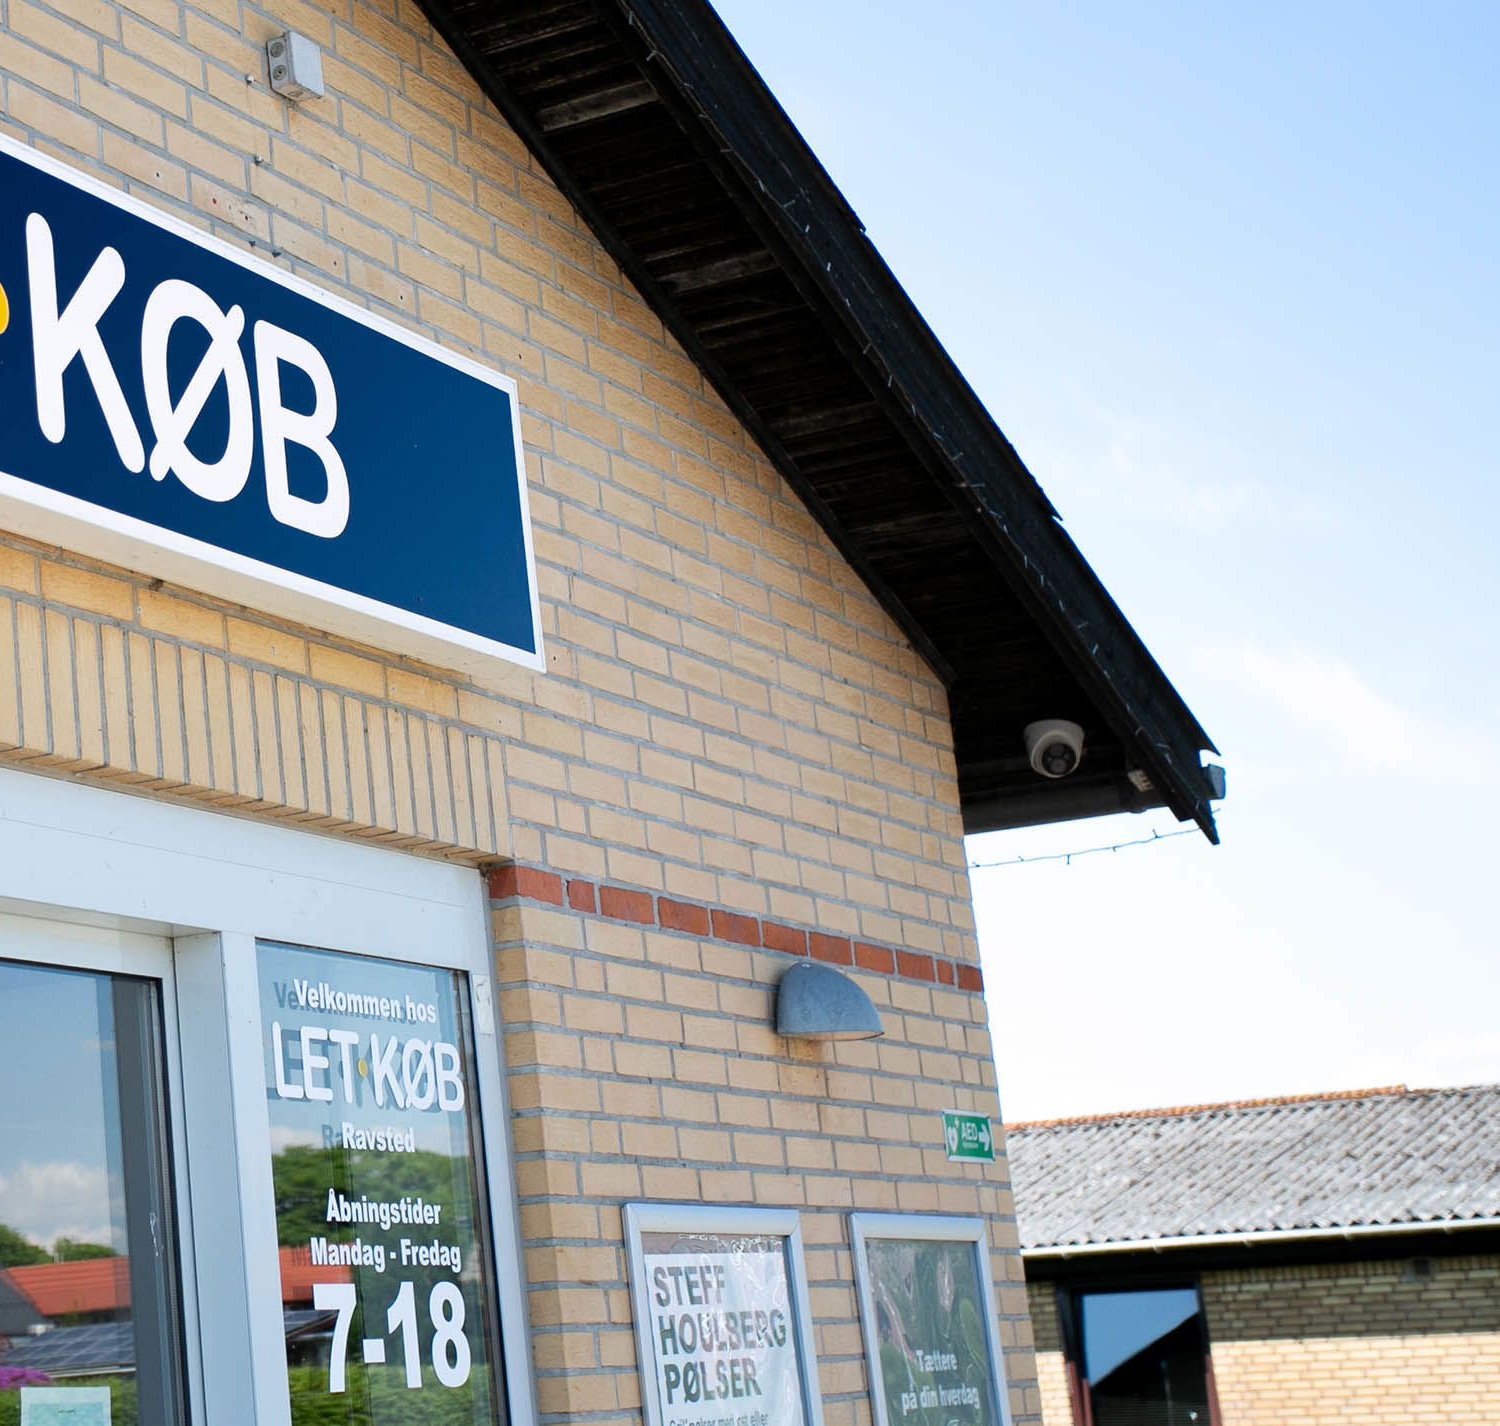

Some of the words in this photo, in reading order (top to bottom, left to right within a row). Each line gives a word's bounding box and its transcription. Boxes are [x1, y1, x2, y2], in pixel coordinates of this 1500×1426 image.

[293, 978, 401, 1019] Velkommen
[405, 994, 437, 1024] hos
[341, 1121, 416, 1153] Ravsted
[961, 1121, 978, 1141] AED
[326, 1187, 442, 1231] Åbningstider
[310, 1237, 386, 1273] Mandag
[399, 1238, 462, 1274] Fredag
[653, 1265, 725, 1308] STEFF
[312, 1280, 472, 1394] 7-18
[658, 1309, 787, 1356] HOULBERG
[664, 1358, 763, 1405] PØLSER
[915, 1349, 958, 1373] Tættere
[901, 1382, 918, 1416] på
[920, 1384, 938, 1409] din
[938, 1382, 980, 1410] hverdag
